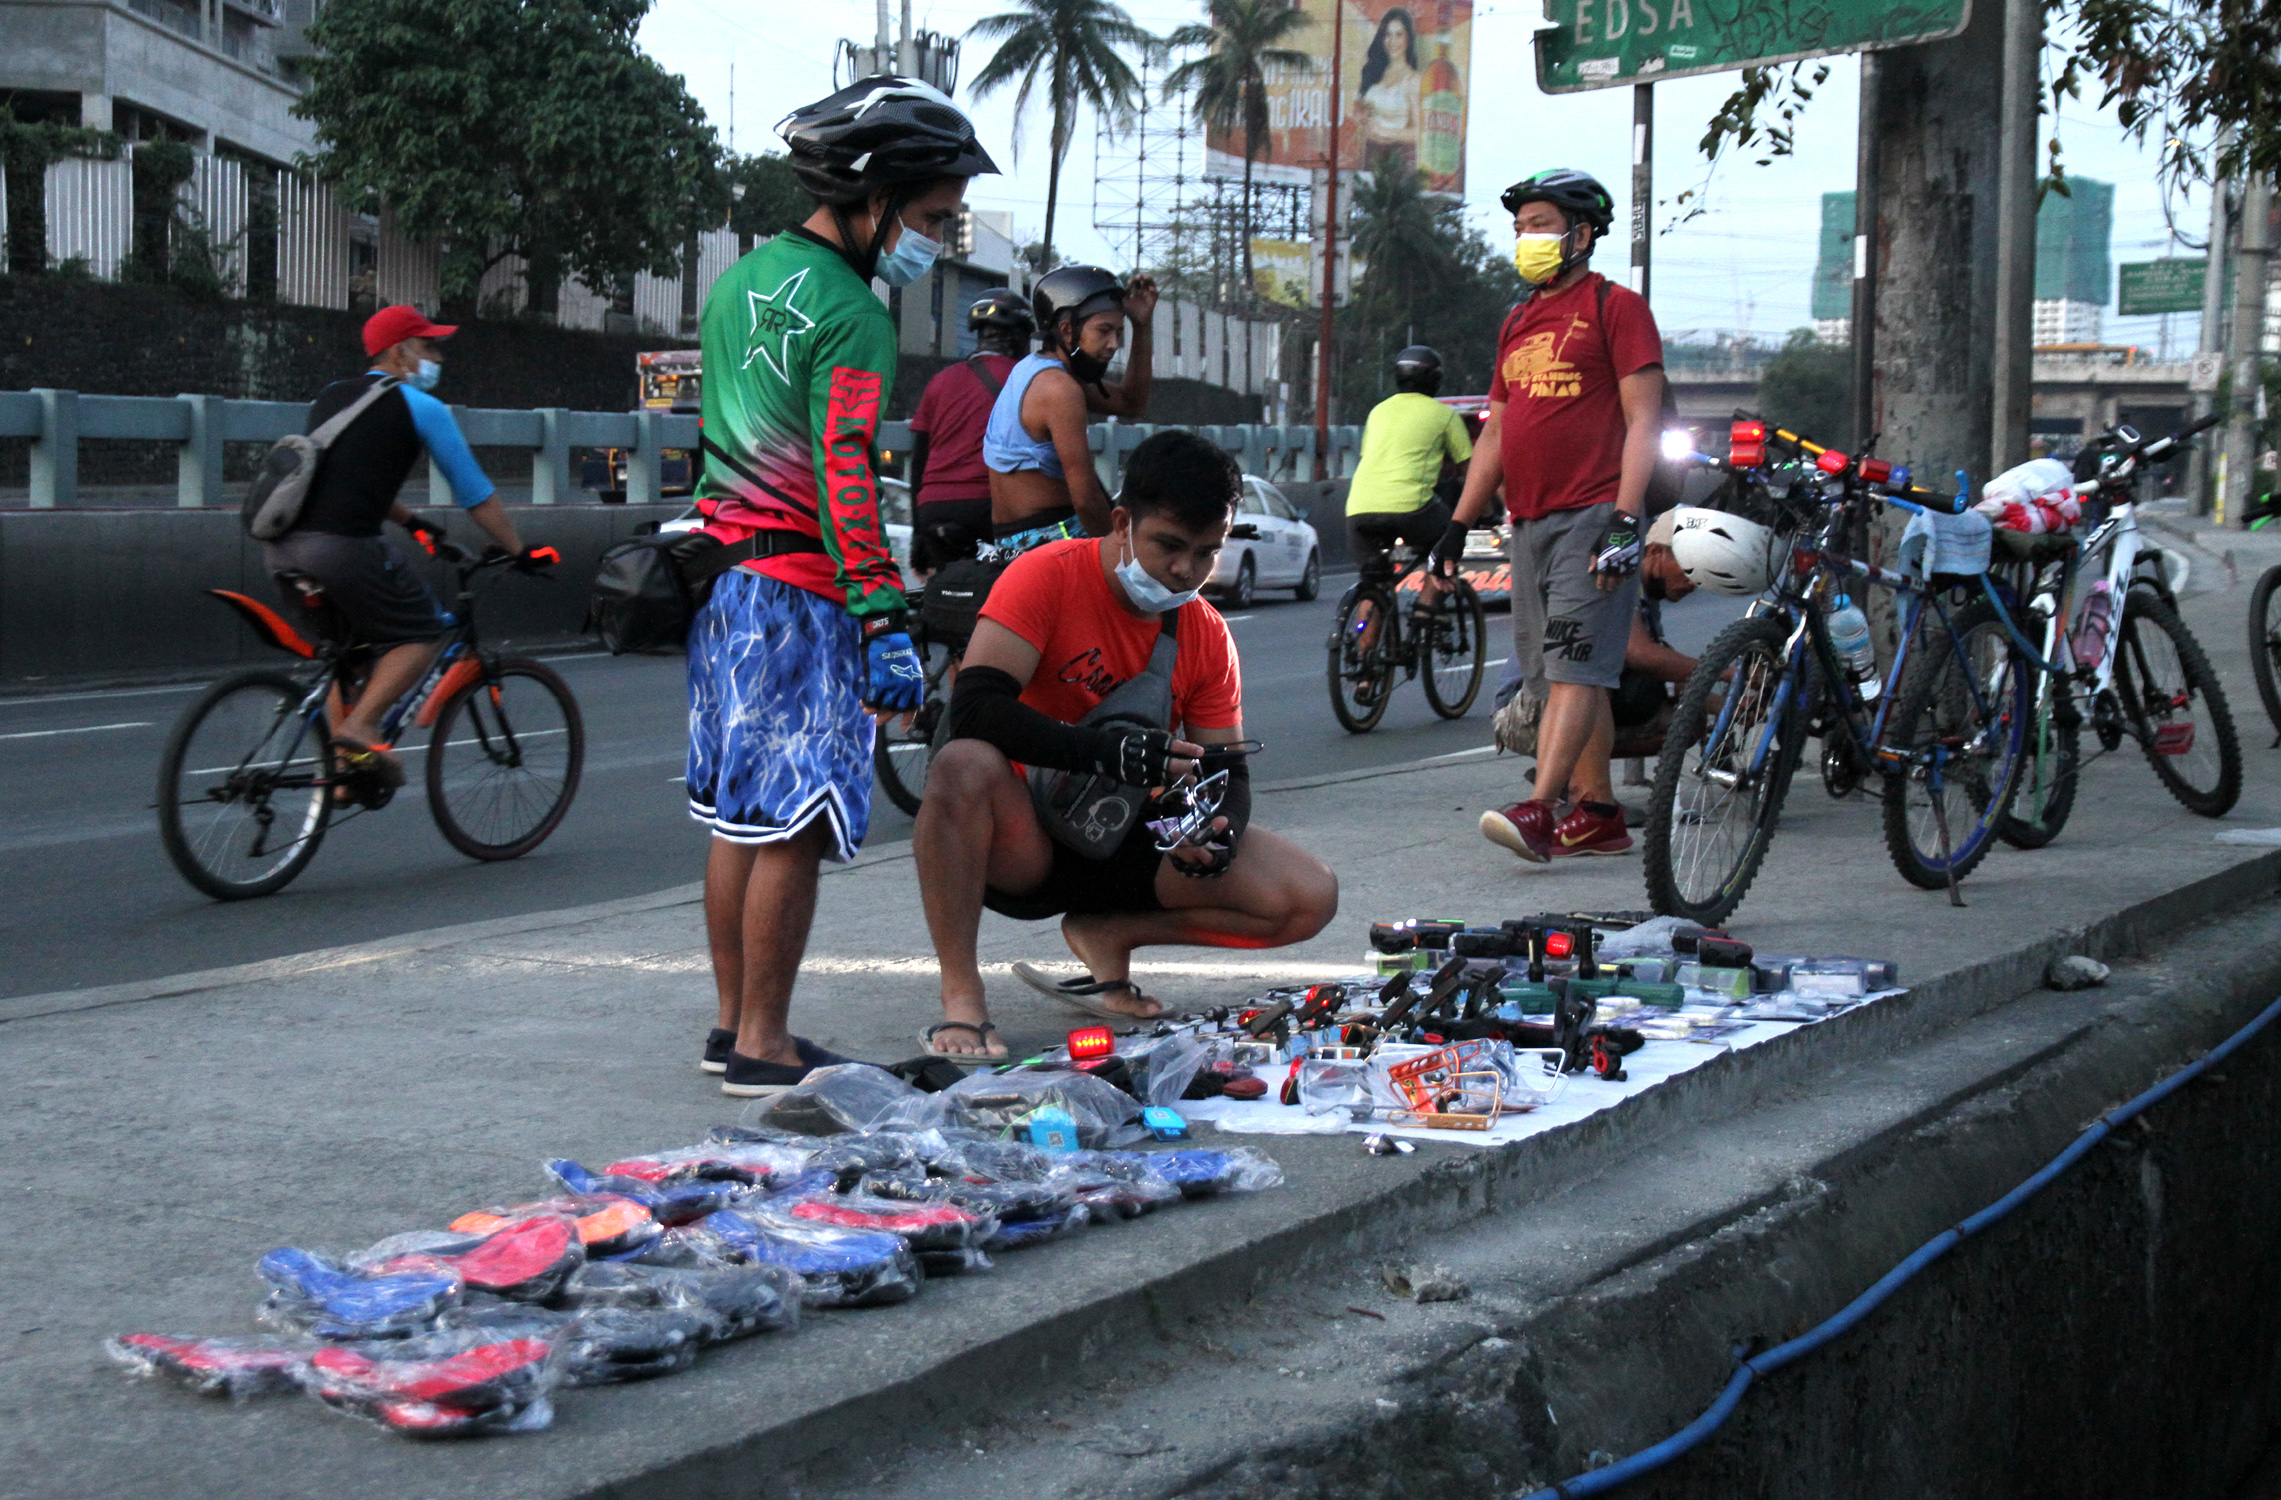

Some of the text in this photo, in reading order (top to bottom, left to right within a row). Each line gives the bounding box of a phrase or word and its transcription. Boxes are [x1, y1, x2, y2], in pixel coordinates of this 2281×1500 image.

[1575, 0, 1694, 44] EDSA
[1544, 618, 1584, 642] NIKE
[1558, 642, 1593, 662] AIR
